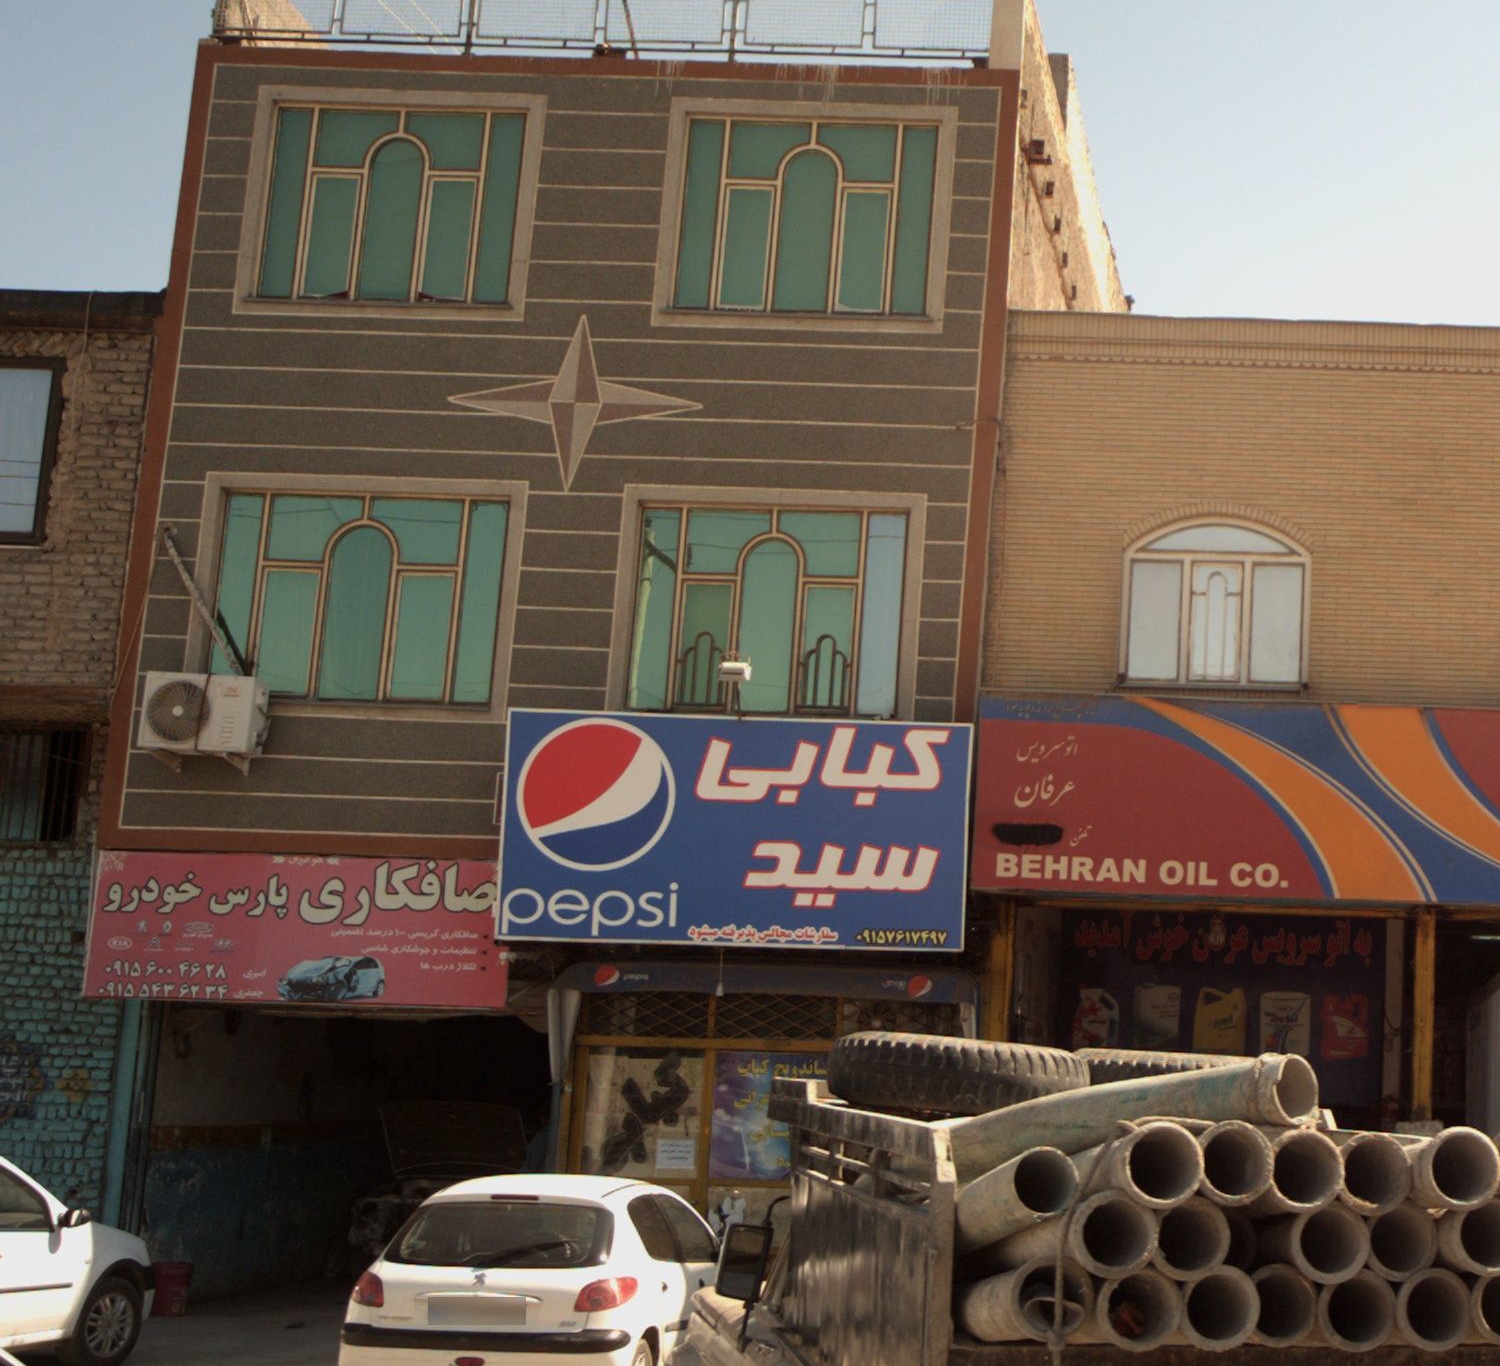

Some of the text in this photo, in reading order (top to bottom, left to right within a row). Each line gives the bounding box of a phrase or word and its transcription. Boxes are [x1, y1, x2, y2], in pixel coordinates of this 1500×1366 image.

[696, 724, 951, 806] کبابی
[1014, 774, 1076, 808] عرفان
[102, 860, 498, 927] صافکاری پارس خودرو
[743, 840, 940, 907] سید
[994, 852, 1289, 889] BEHRAN OIL CO.
[501, 882, 680, 936] pepsi
[1135, 913, 1190, 963] خوش
[1252, 926, 1323, 966] سرویس
